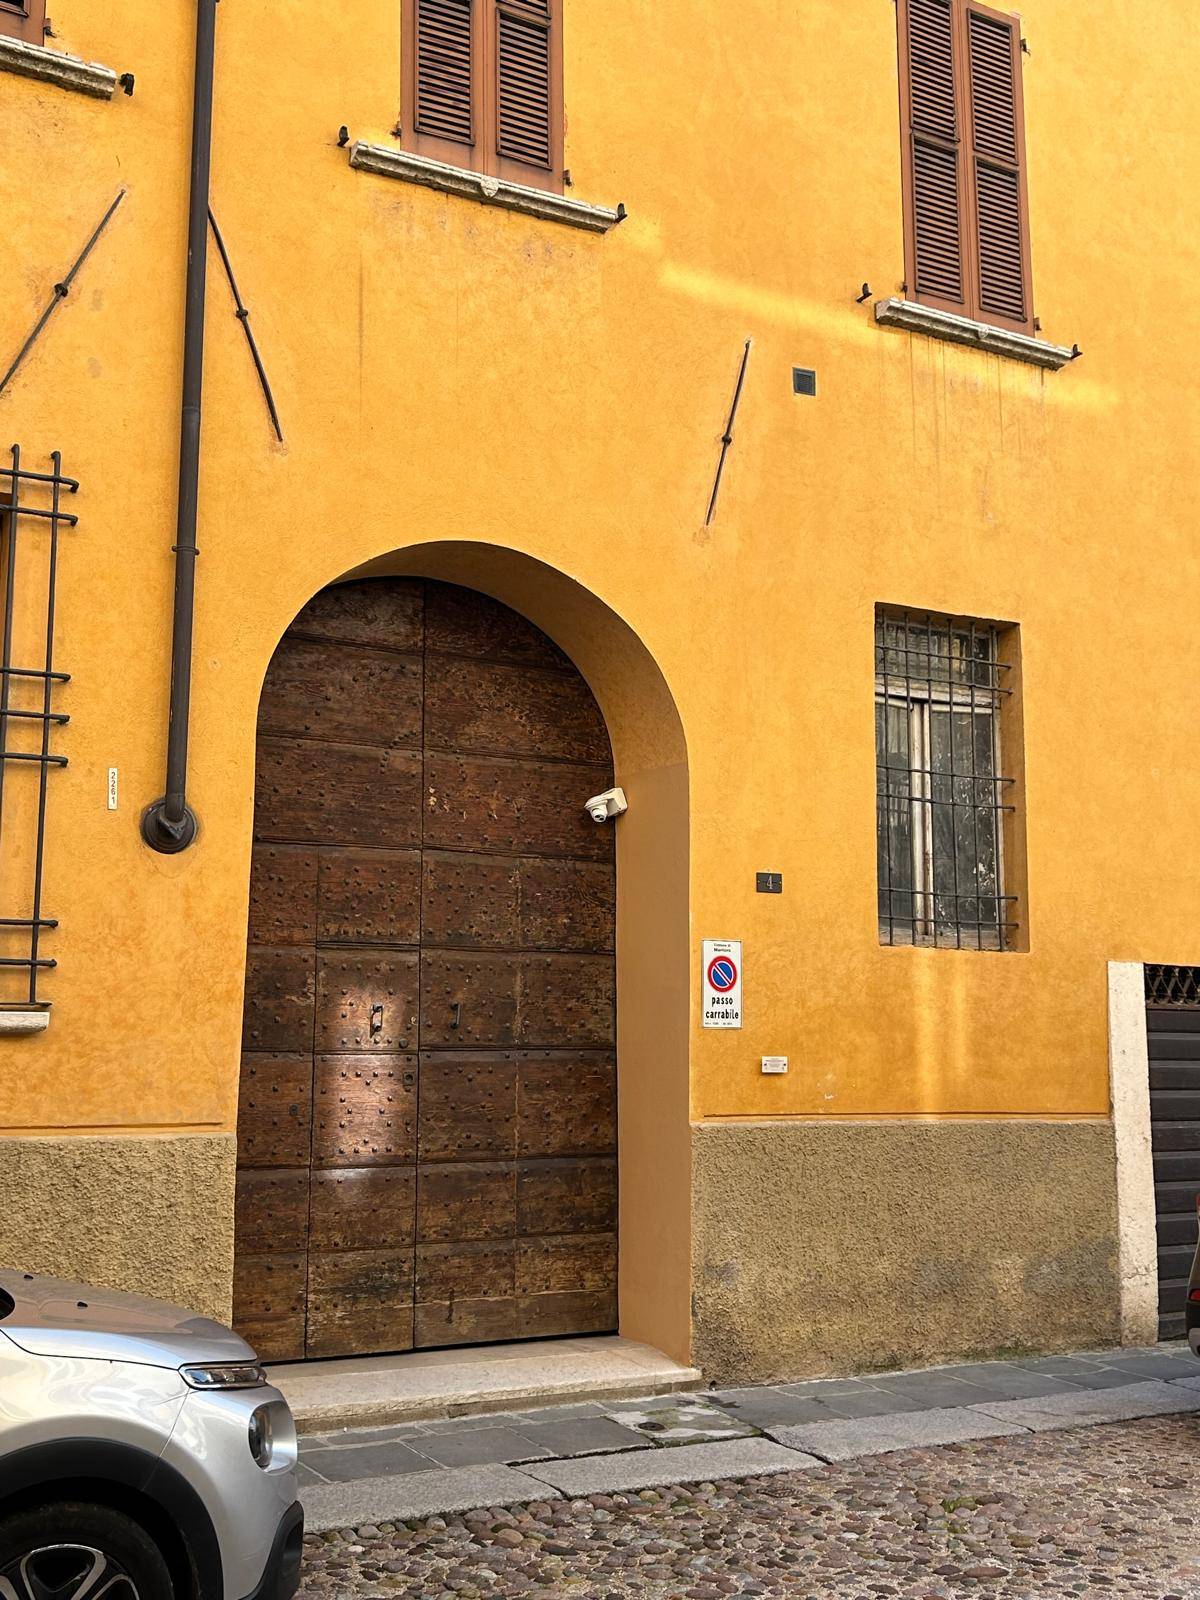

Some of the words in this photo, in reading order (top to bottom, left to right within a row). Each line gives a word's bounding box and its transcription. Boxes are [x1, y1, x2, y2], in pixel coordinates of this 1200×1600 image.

[766, 874, 773, 890] 4
[712, 997, 733, 1007] passo
[705, 1009, 739, 1019] carrabile
